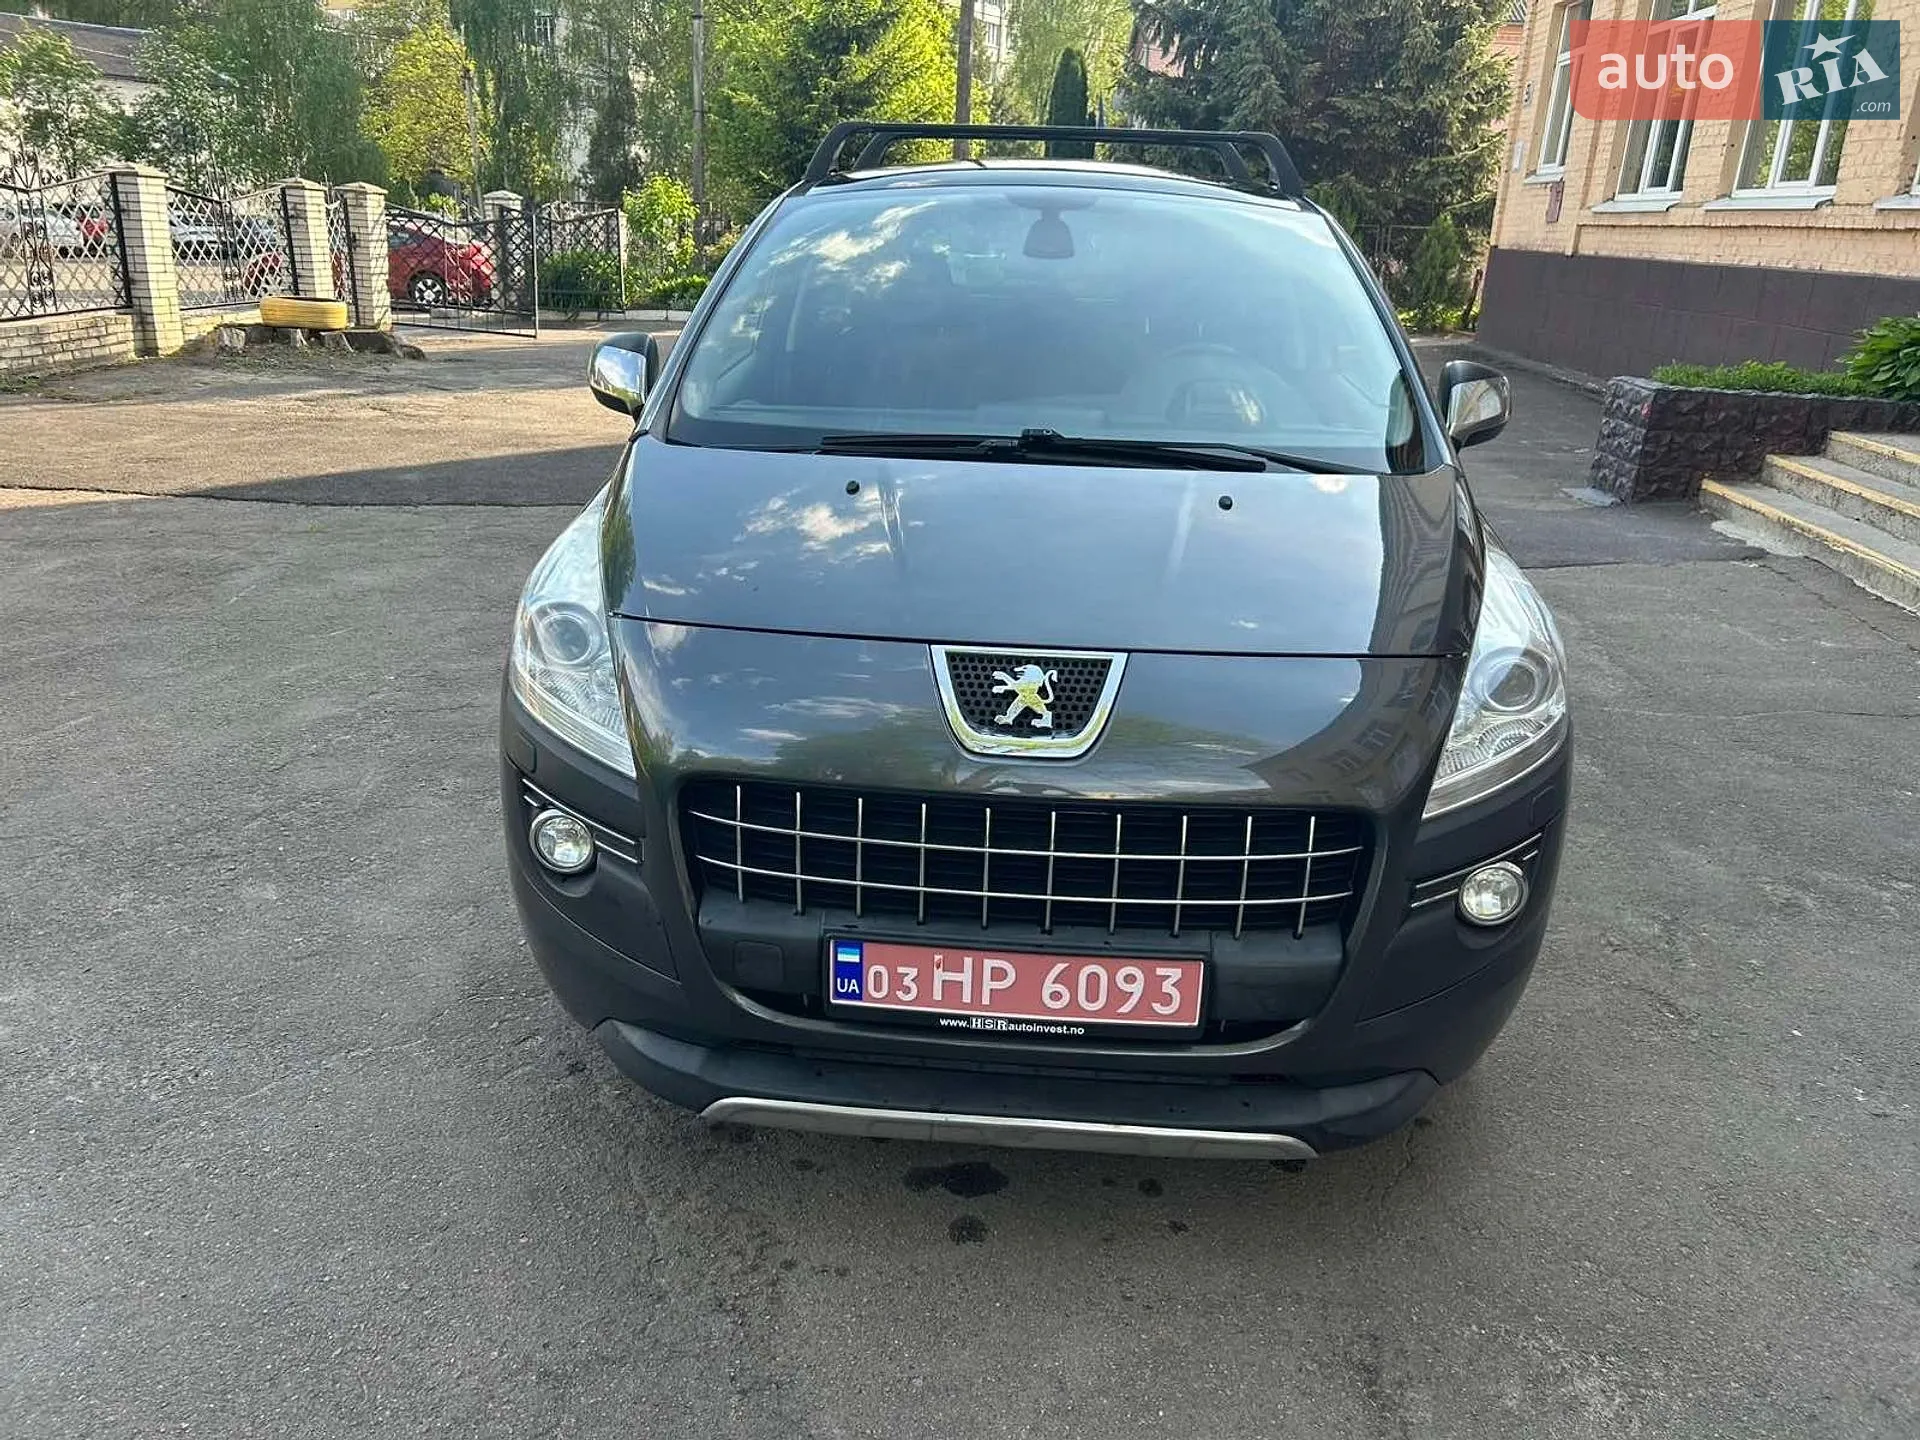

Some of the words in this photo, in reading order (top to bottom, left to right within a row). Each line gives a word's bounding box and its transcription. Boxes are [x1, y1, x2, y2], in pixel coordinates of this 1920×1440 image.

[837, 978, 859, 994] UA
[867, 965, 919, 1001] 03
[933, 954, 1016, 1005] HP
[1041, 963, 1183, 1015] 6093
